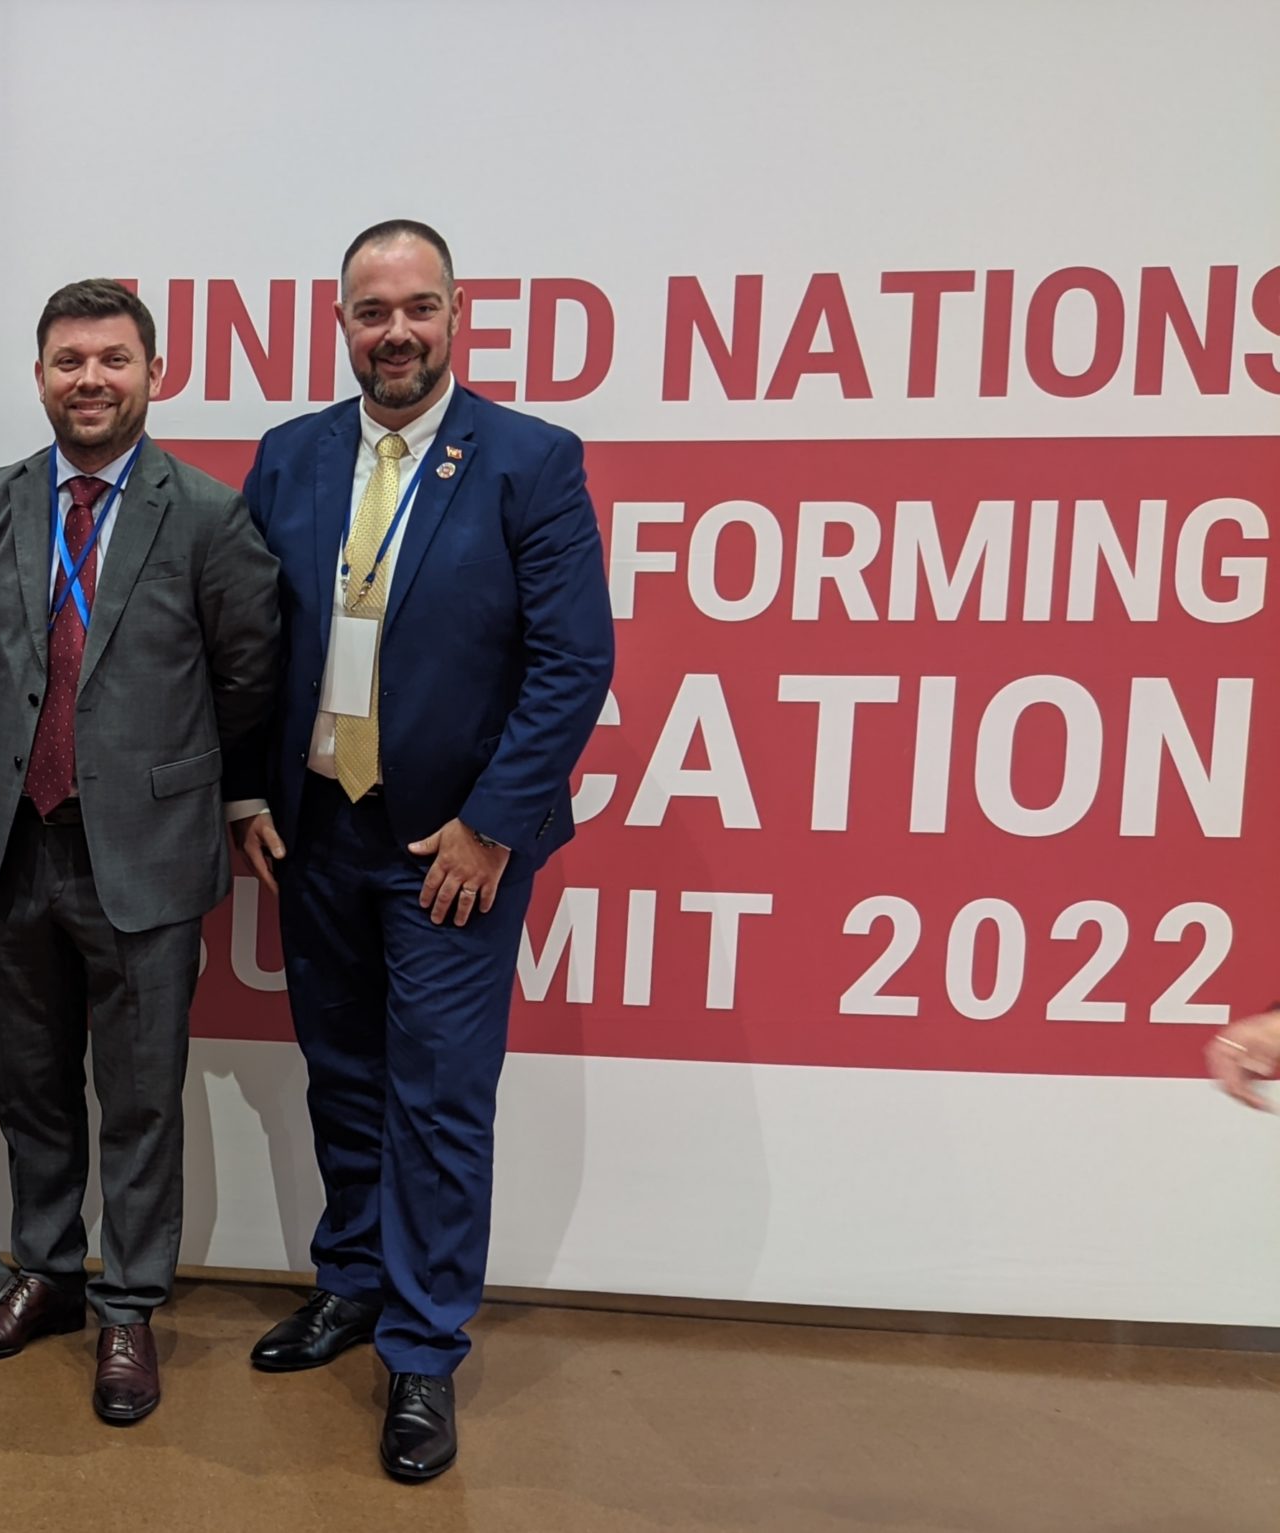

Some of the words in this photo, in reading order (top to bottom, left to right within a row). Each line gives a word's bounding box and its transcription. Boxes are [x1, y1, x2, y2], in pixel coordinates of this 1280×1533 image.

[114, 278, 615, 402] UNIED
[598, 498, 1270, 624] FORMING
[839, 896, 1233, 1025] 2022
